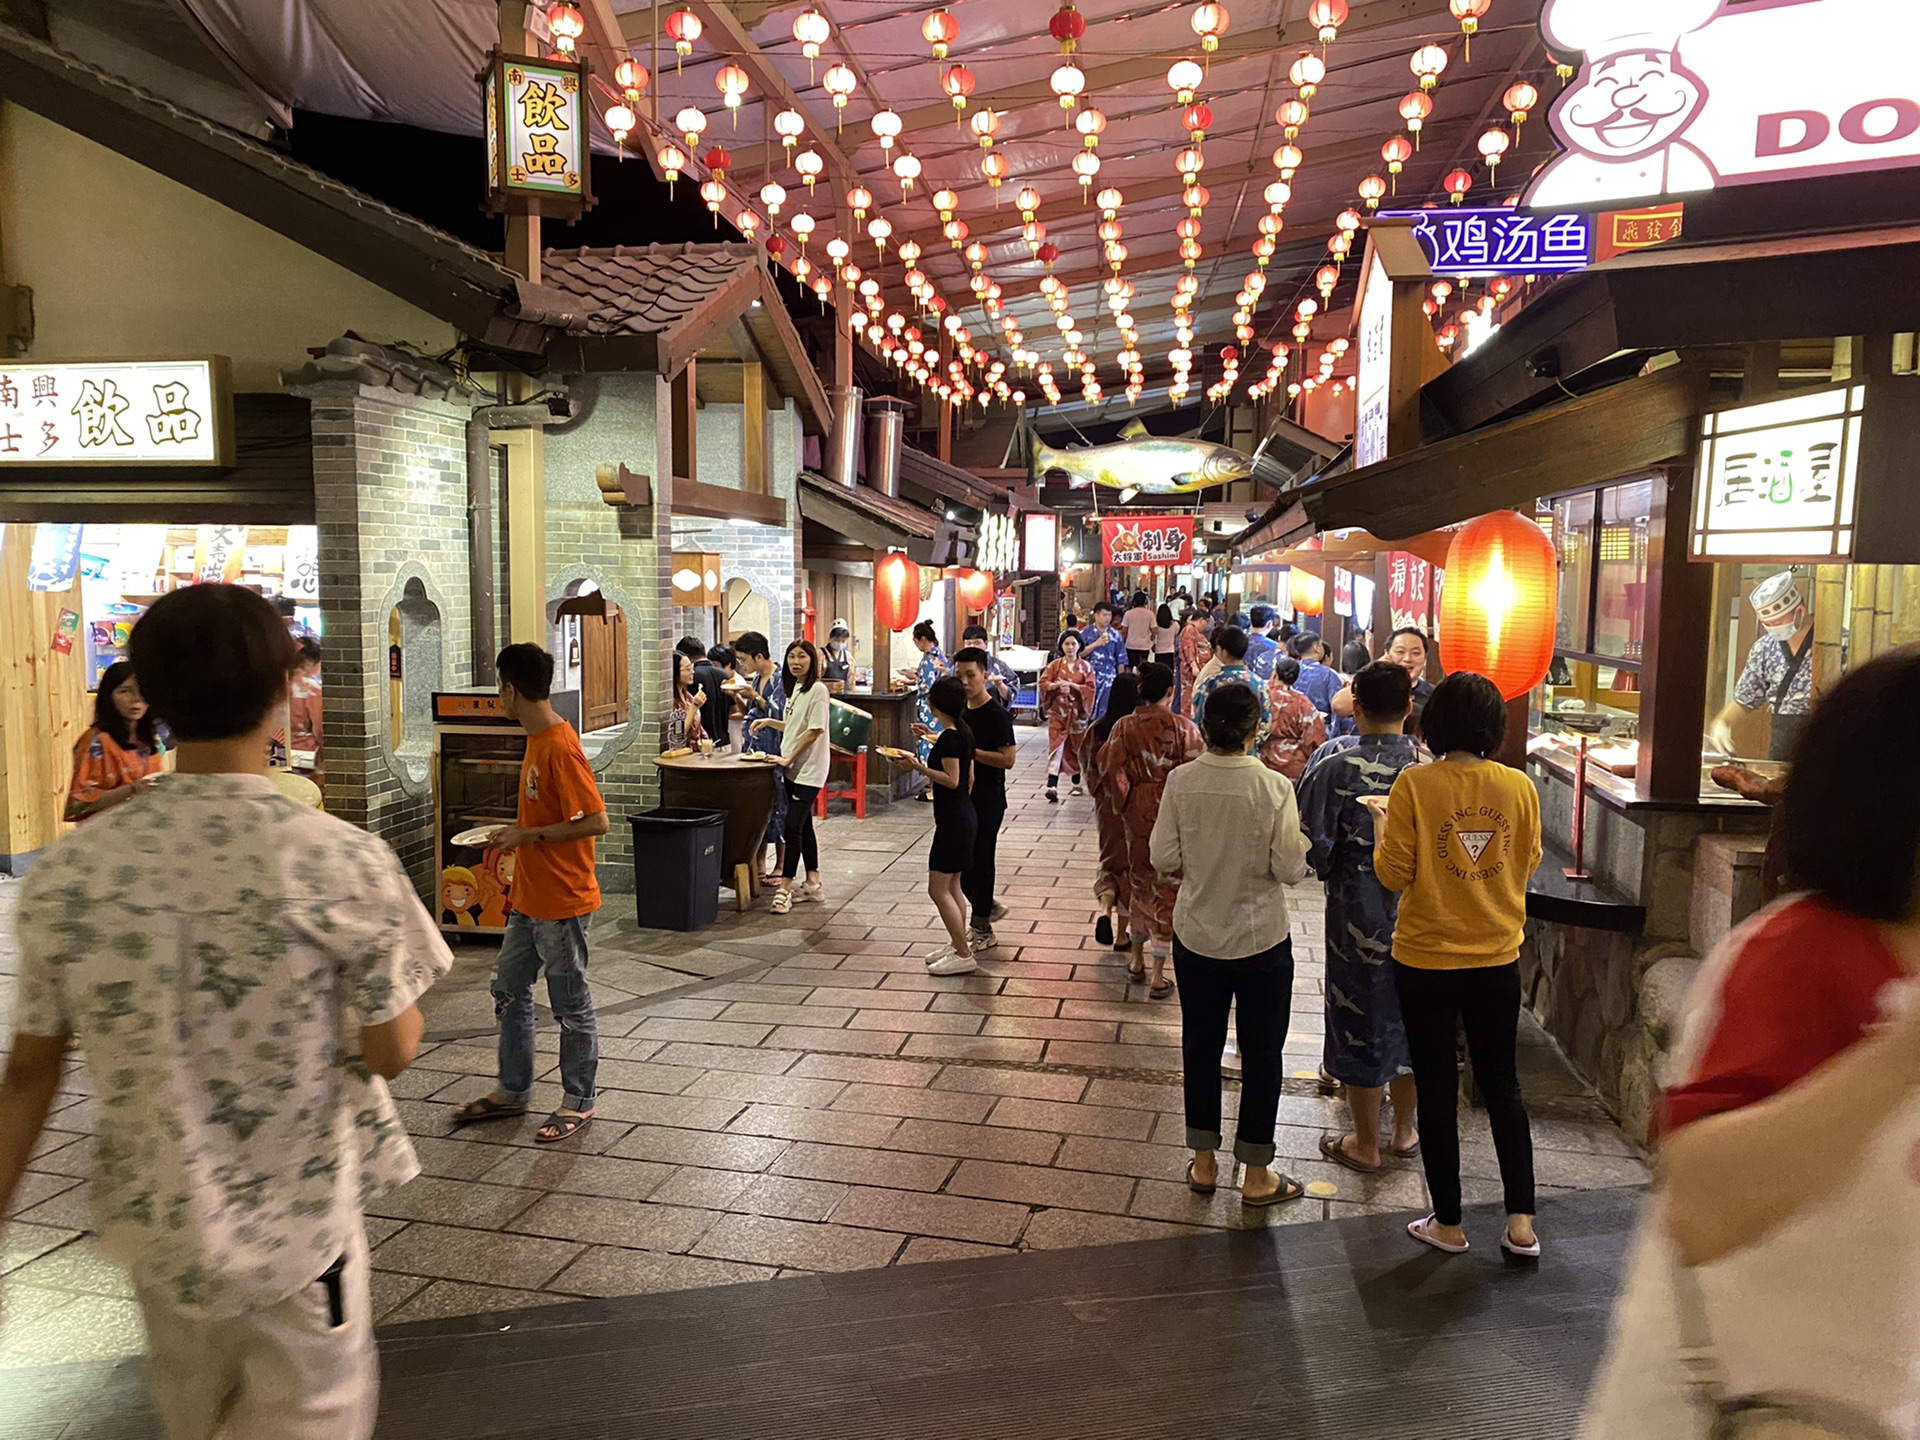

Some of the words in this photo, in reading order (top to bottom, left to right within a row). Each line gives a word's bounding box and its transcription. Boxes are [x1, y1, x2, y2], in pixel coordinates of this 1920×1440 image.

[518, 81, 569, 175] 飲品
[1440, 213, 1588, 263] 鸡汤鱼
[70, 378, 202, 448] 飲品
[1143, 528, 1186, 552] 刺身
[1147, 552, 1179, 560] Sashimi
[1479, 805, 1510, 832] GUESS
[1437, 821, 1453, 858] GUESS
[1470, 861, 1504, 882] GUESS
